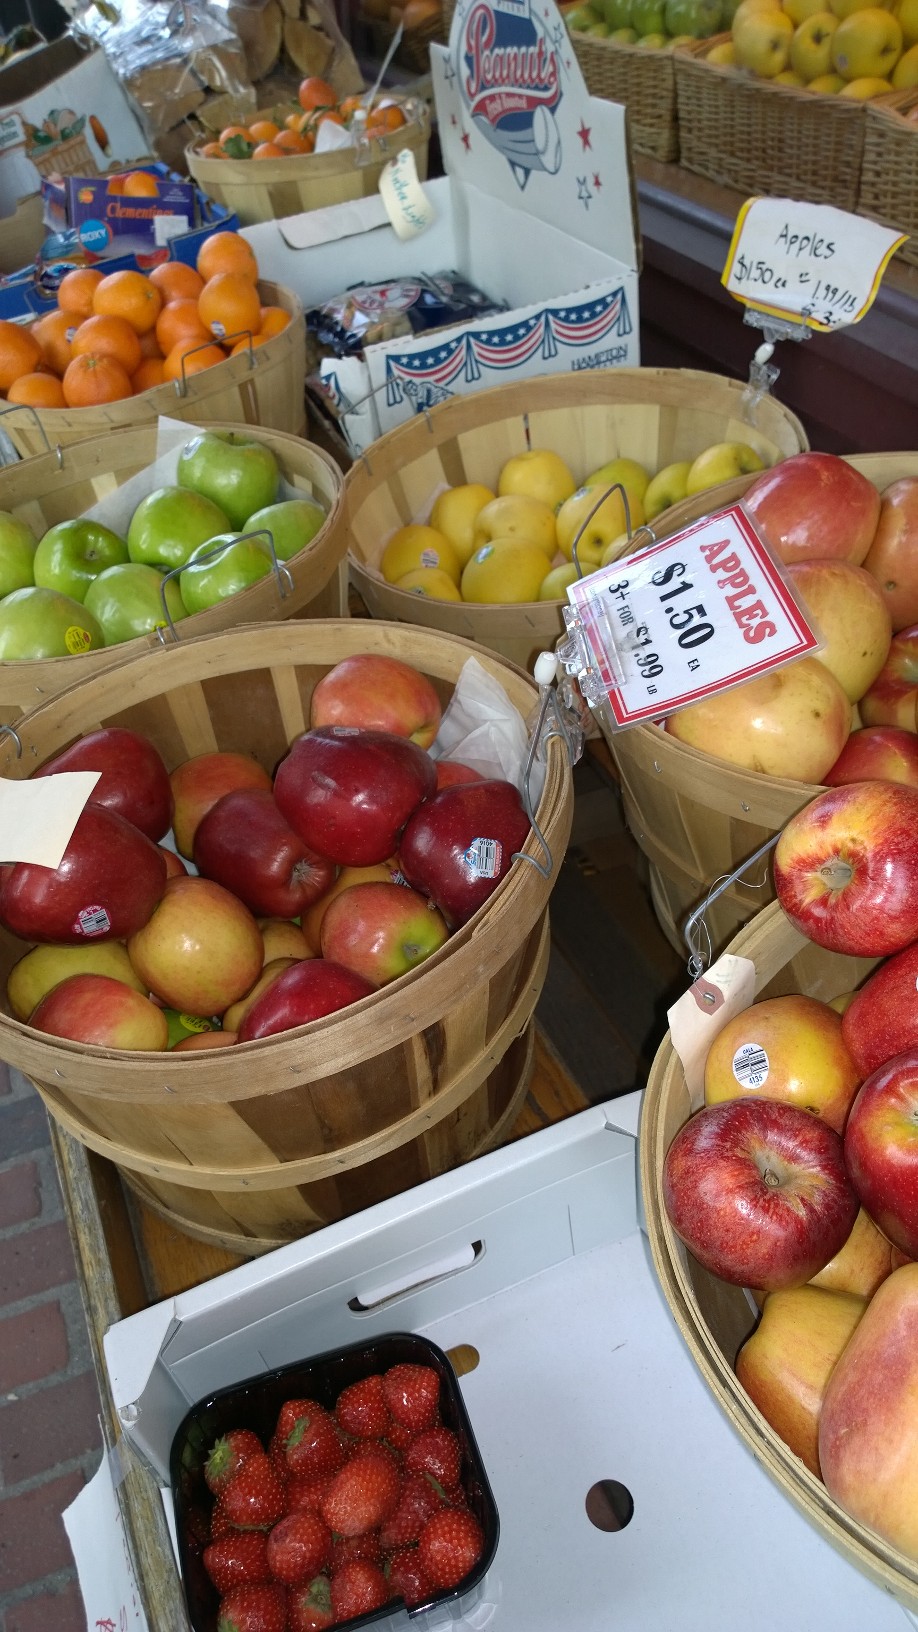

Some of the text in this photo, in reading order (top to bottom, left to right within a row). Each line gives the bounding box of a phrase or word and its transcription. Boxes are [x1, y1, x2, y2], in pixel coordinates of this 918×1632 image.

[465, 3, 558, 101] Peanuts
[775, 223, 836, 260] Apples
[571, 342, 629, 371] HAMPTON
[608, 579, 665, 695] 3+ FOR $1.99 LB
[648, 561, 716, 672] $1.50 EA
[699, 538, 778, 645] APPLES
[749, 1074, 763, 1085] 4135
